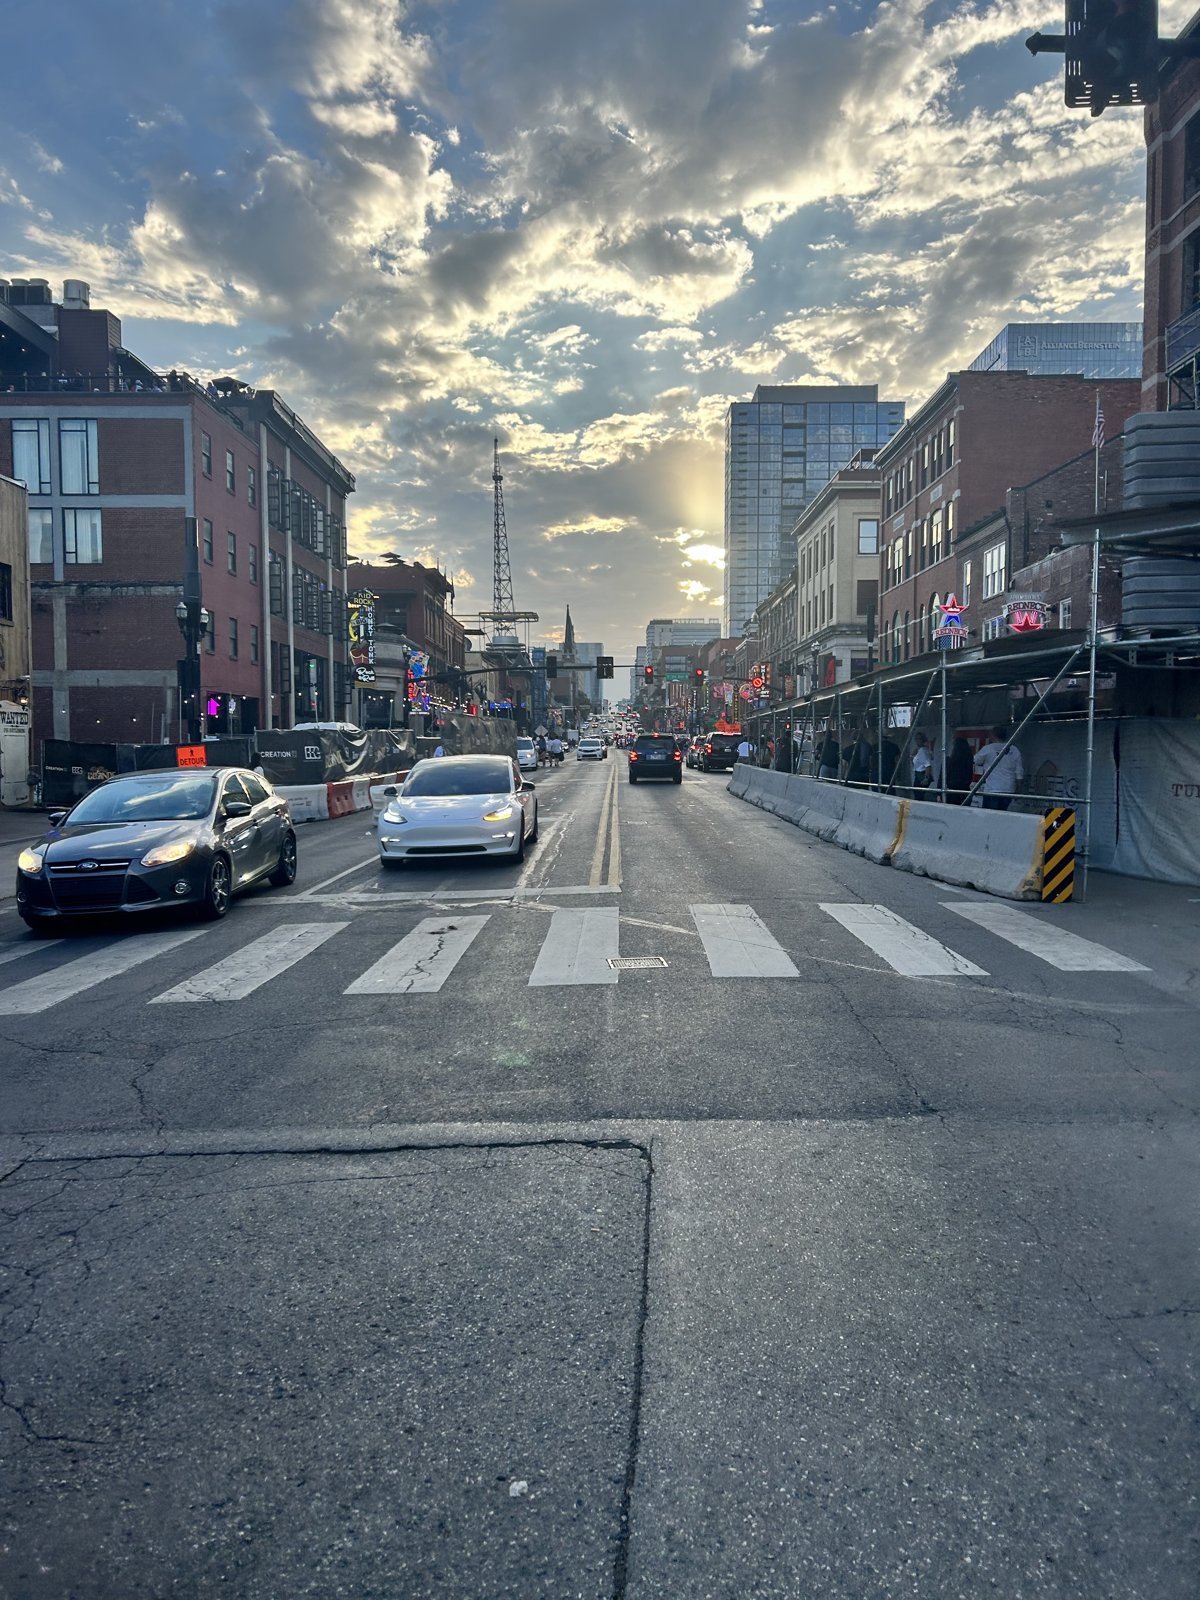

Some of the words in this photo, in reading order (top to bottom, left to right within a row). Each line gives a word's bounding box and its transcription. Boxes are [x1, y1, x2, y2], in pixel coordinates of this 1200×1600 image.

[1007, 601, 1047, 612] REDNECK
[935, 627, 967, 637] REDNECK
[0, 711, 28, 725] WANTED
[180, 757, 207, 766] DETOUR
